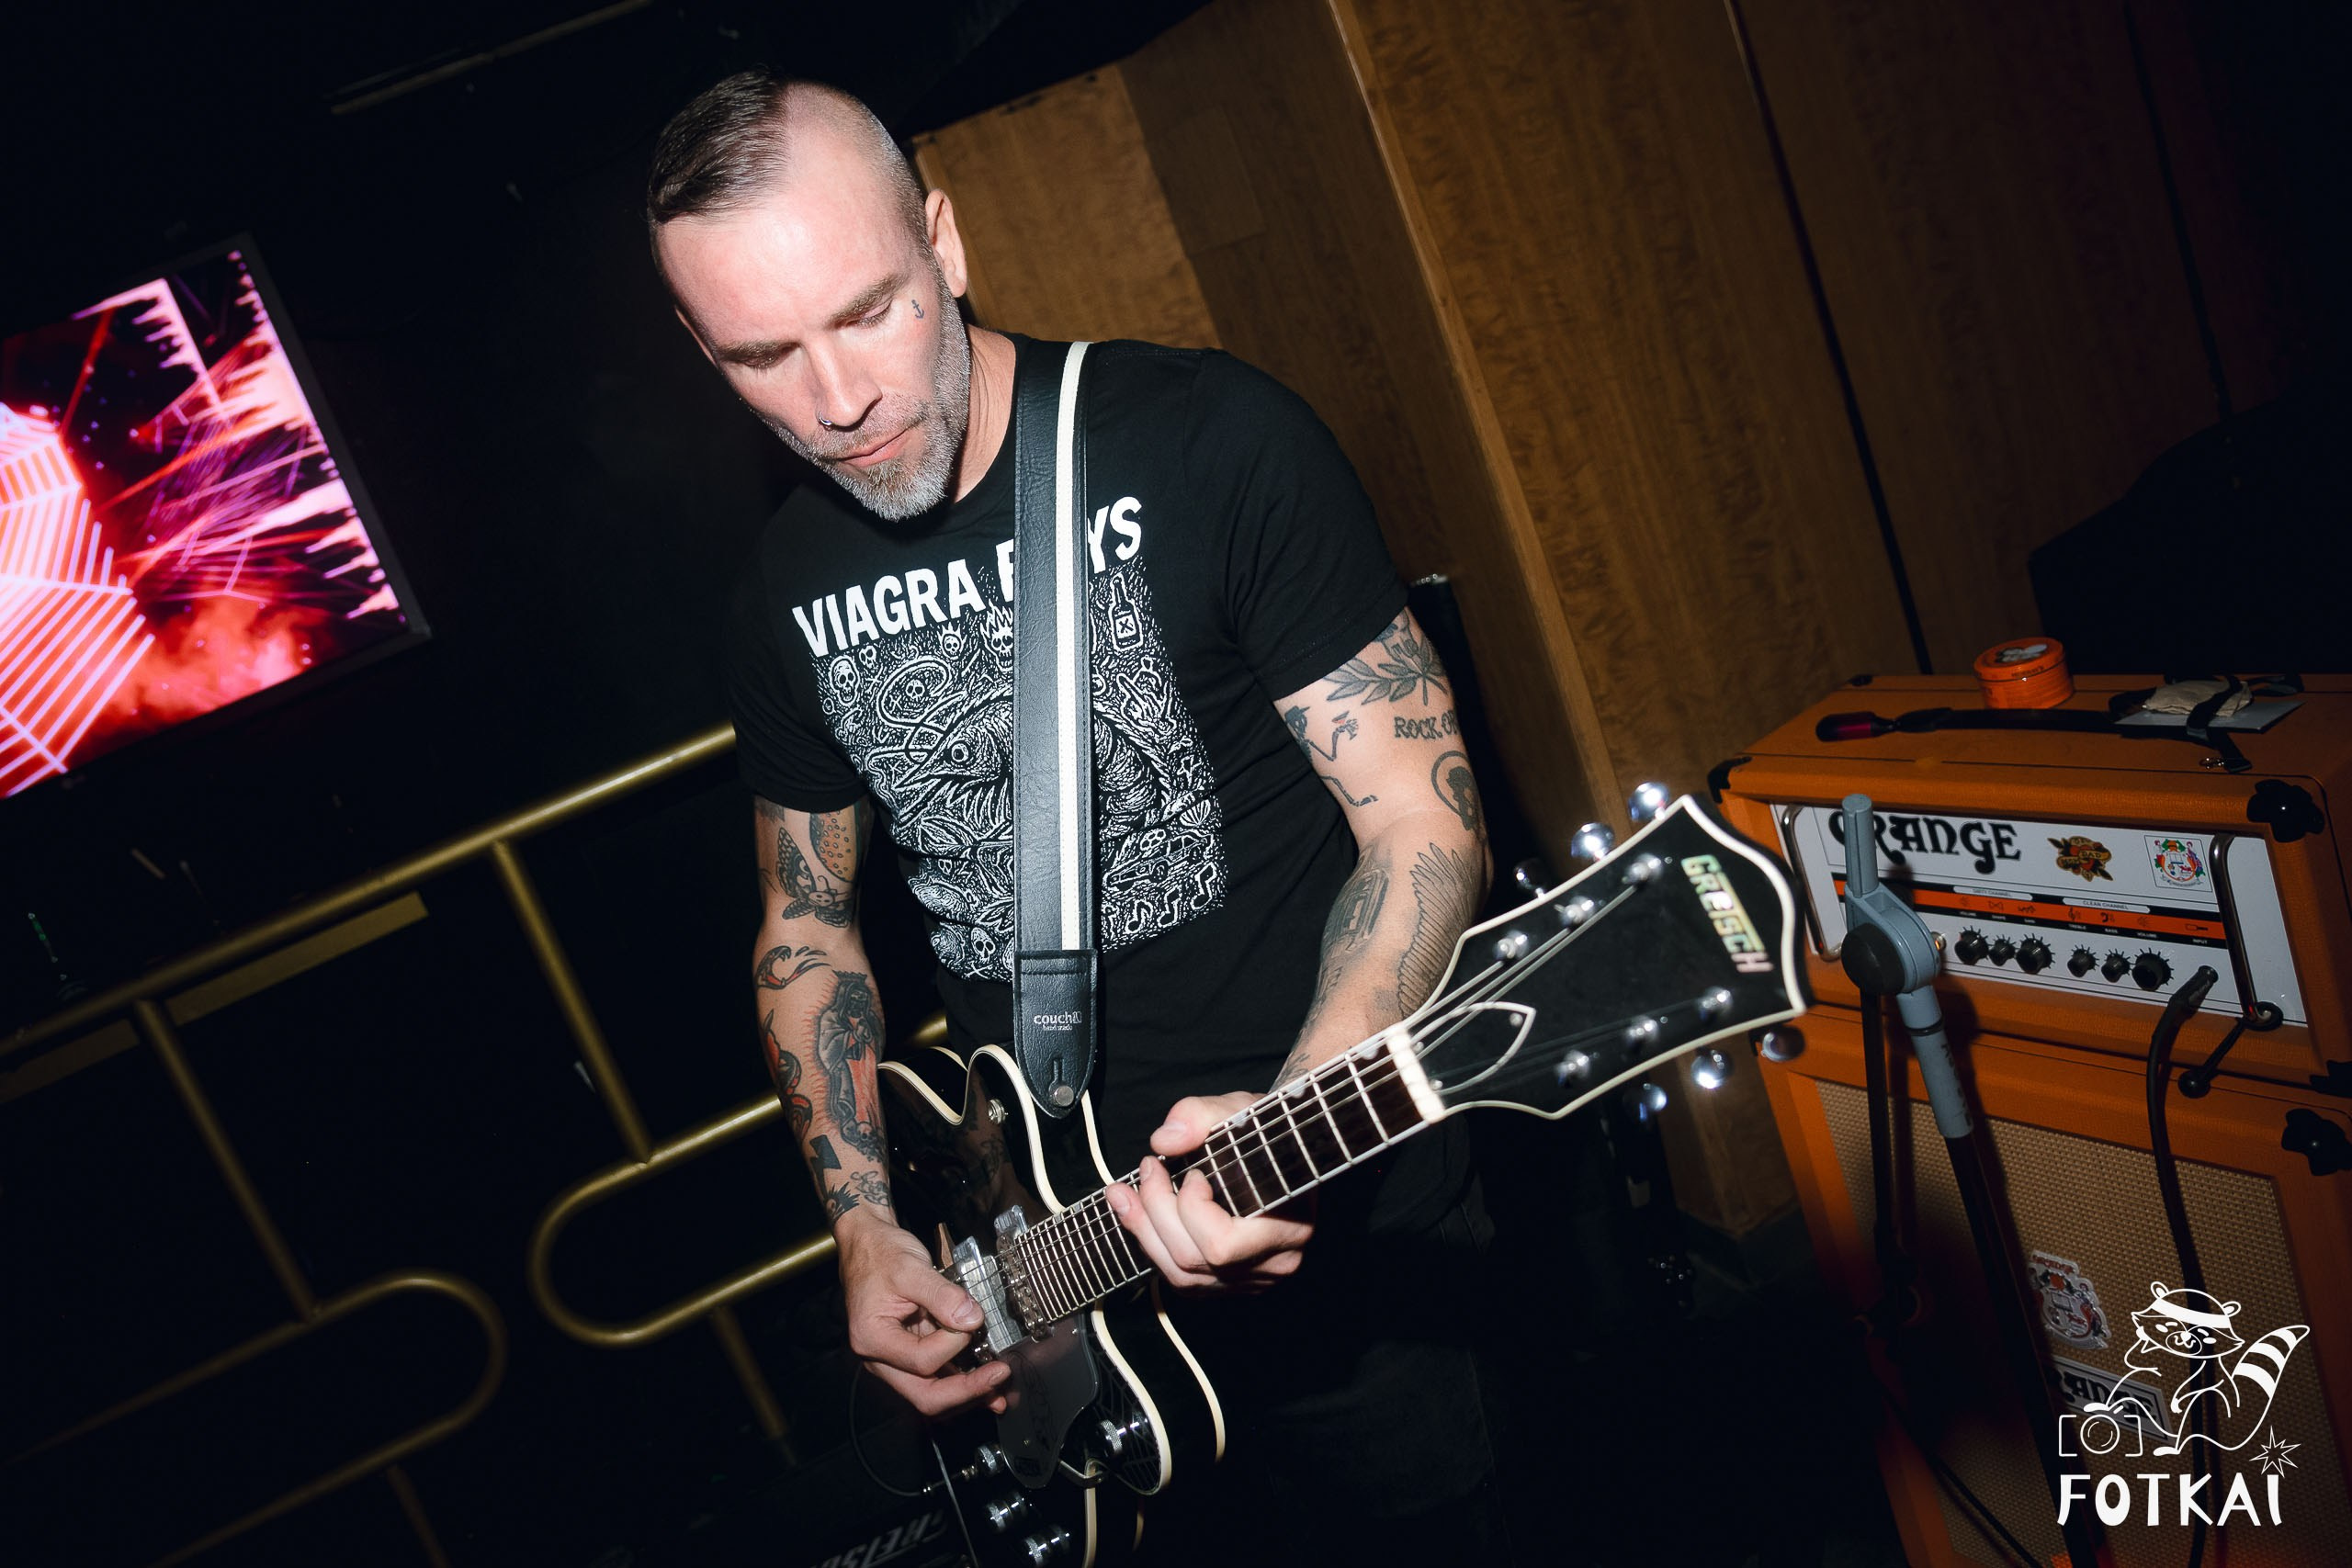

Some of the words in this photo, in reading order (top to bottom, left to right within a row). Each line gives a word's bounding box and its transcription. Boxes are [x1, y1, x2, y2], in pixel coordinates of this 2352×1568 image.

[790, 558, 985, 659] VIAGRA
[995, 495, 1143, 603] YS
[1394, 716, 1443, 739] ROCK
[1681, 854, 1774, 974] GRETSCH
[2102, 902, 2129, 910] CHANNEL
[1034, 1010, 1072, 1024] couch
